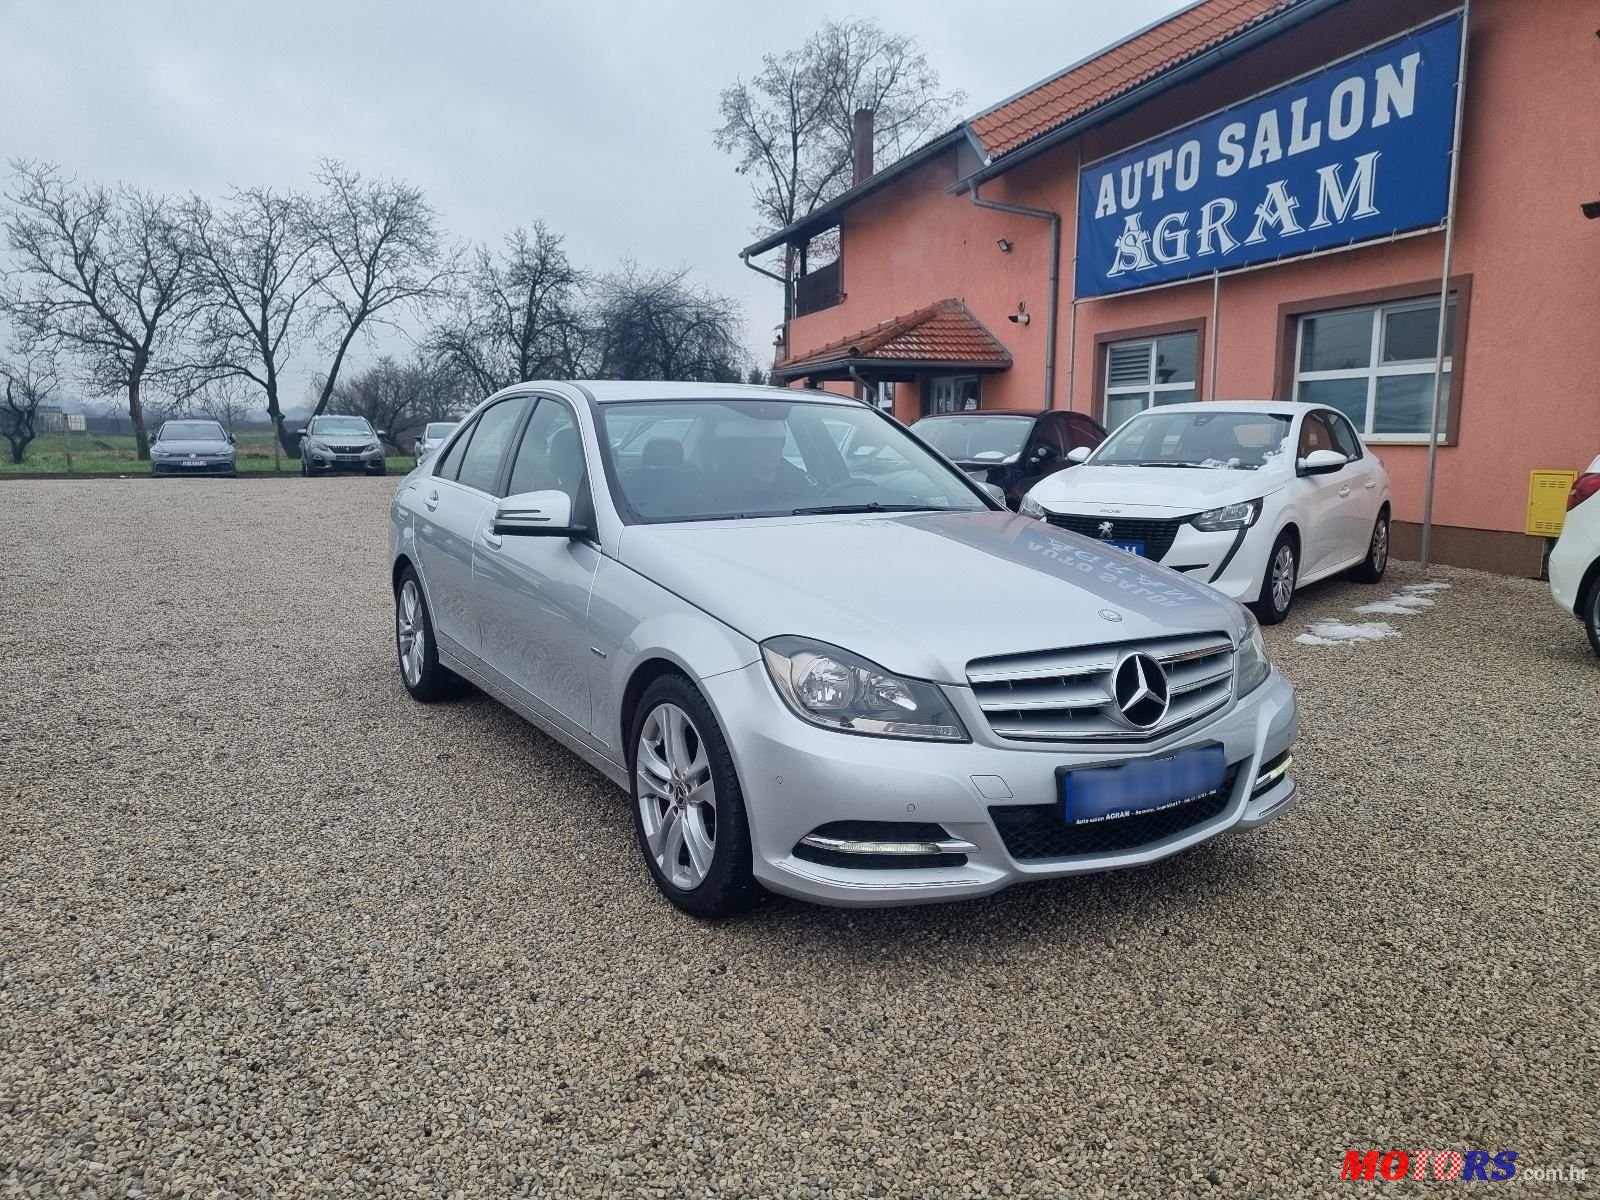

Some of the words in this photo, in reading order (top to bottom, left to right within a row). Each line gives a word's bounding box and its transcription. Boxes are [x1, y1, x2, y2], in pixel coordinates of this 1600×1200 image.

[1095, 139, 1201, 219] AUTO
[1216, 51, 1421, 178] SALON
[1106, 151, 1382, 278] AGRAM
[1105, 811, 1130, 820] AGRAM
